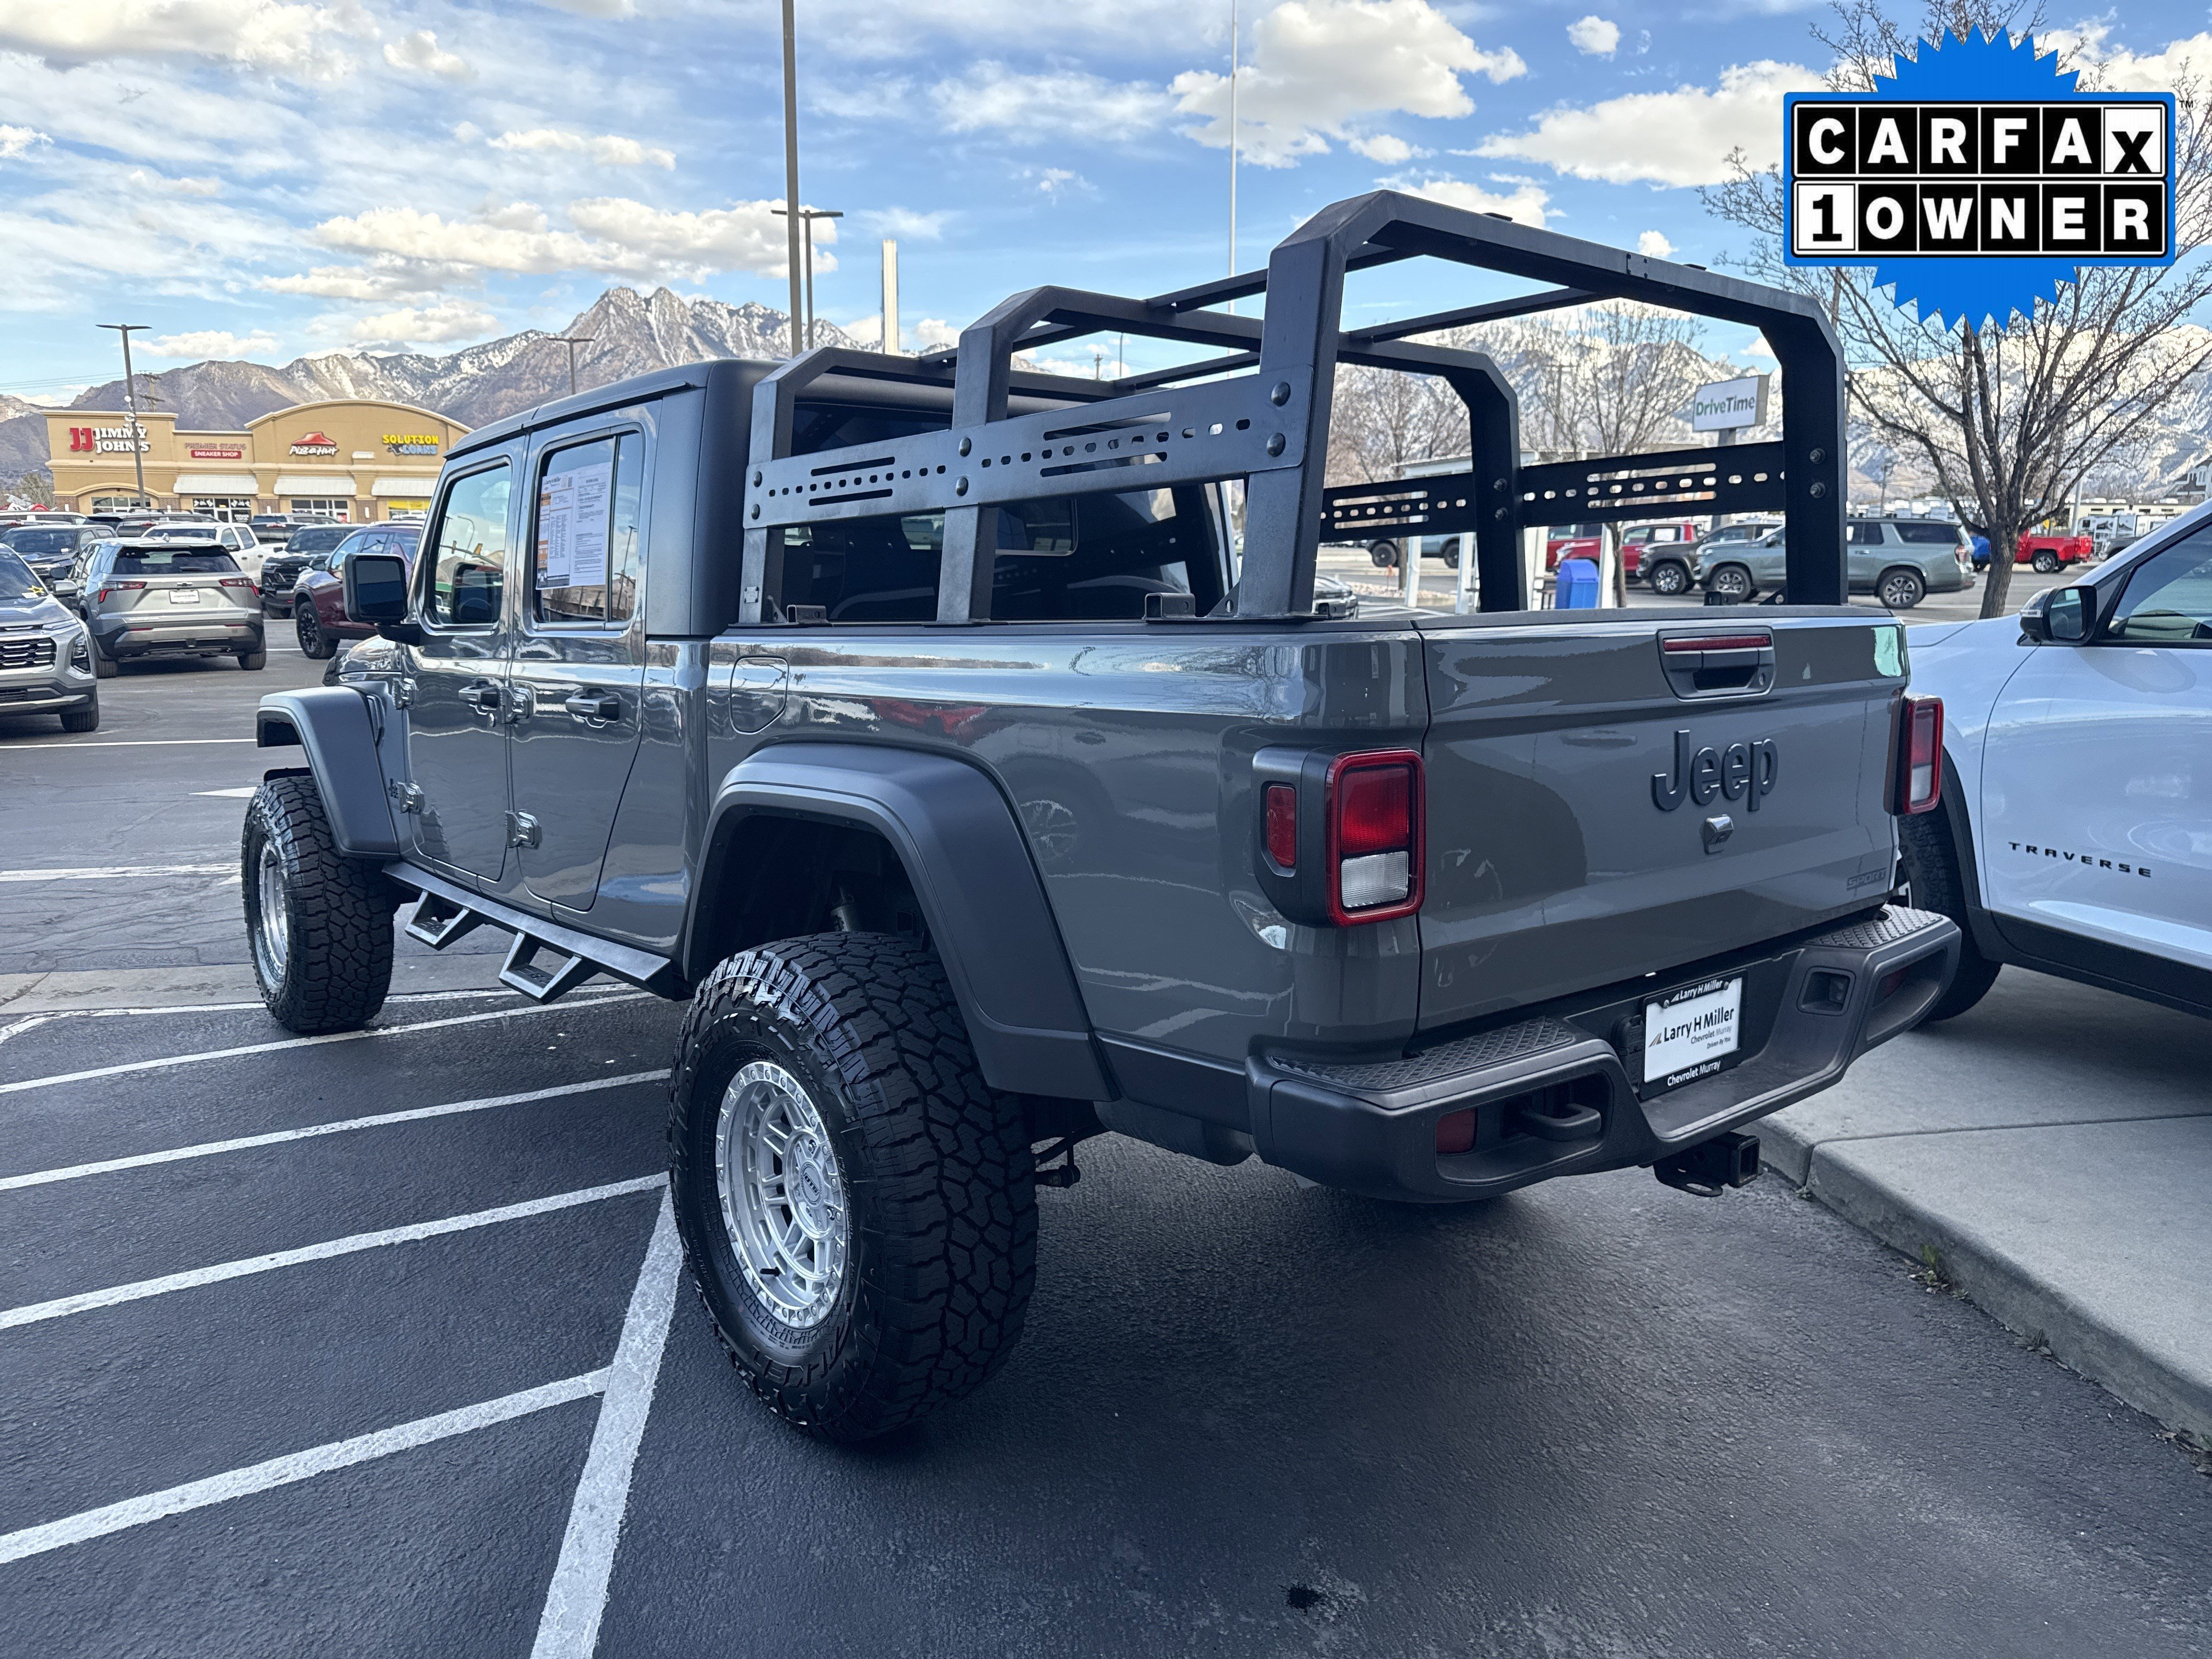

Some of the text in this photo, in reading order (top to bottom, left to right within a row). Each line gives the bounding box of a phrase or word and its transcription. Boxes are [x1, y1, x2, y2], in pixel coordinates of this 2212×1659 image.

[1696, 395, 1755, 416] DriveTime
[94, 428, 147, 440] JIMMY
[382, 434, 439, 444] SOLUTION
[289, 445, 339, 456] Pizza Hut
[403, 444, 437, 455] LOANS
[1651, 730, 1778, 812] Jeep
[2008, 842, 2151, 877] TRAVERSE
[1847, 868, 1886, 889] SPORT
[1680, 979, 1723, 1000] Larry H Miller
[1664, 1007, 1734, 1041] Larry H Miller
[1691, 1025, 1731, 1044] Chevrolet Murray
[1707, 1040, 1718, 1049] Driven
[1667, 1060, 1721, 1086] Chevrolet Murray
